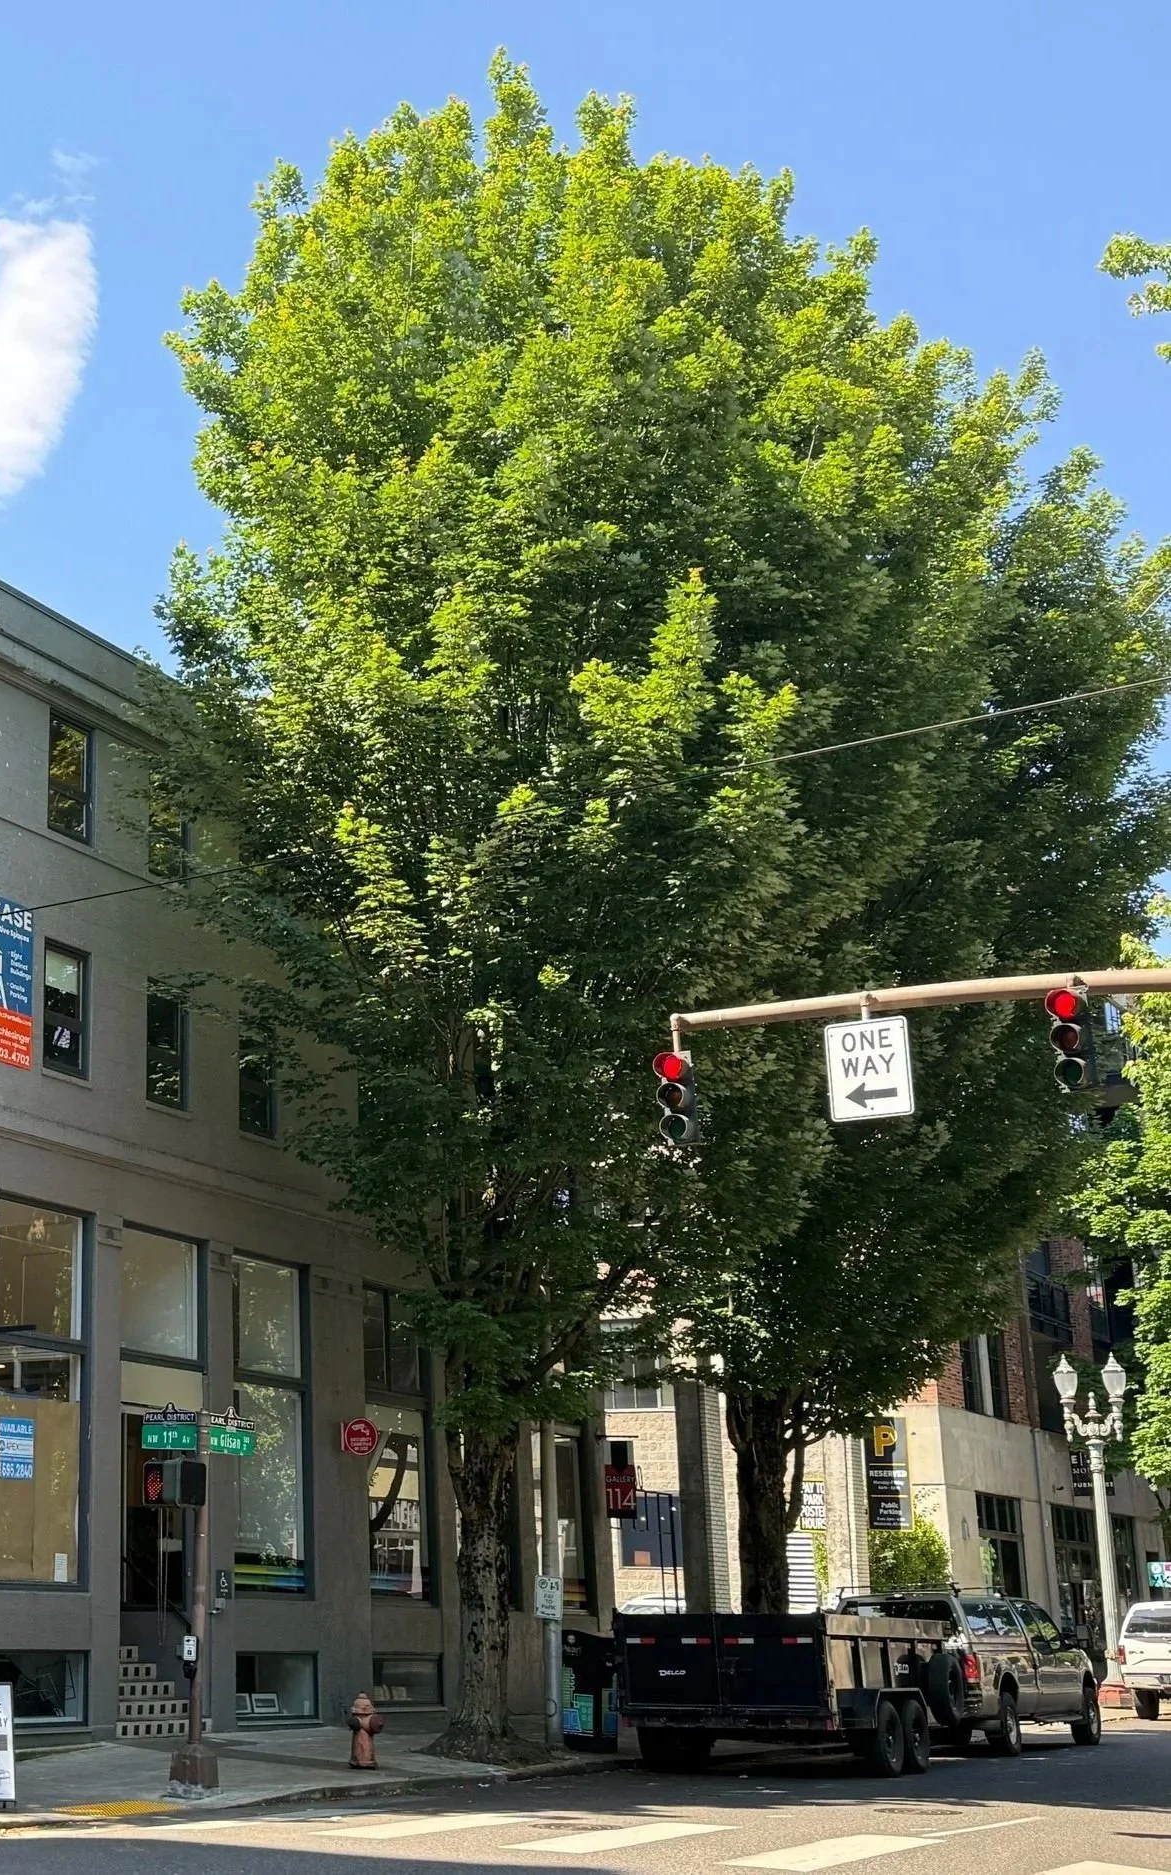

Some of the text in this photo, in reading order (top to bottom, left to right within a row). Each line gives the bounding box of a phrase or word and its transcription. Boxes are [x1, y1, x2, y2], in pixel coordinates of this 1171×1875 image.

[10, 929, 30, 943] Spaces
[11, 959, 28, 971] Distinct
[10, 967, 32, 981] Buildings
[10, 982, 25, 993] Onsite
[10, 990, 28, 1004] Parking
[841, 1027, 893, 1053] ONE
[841, 1052, 895, 1078] WAY
[145, 1413, 195, 1421] PEARL DISTRICT
[211, 1415, 254, 1429] EARL DISTRICT
[147, 1434, 158, 1444] NW
[220, 1433, 241, 1450] Glisan
[874, 1424, 898, 1457] P
[606, 1475, 635, 1483] GALLERY
[869, 1469, 907, 1478] RESERVED
[606, 1488, 636, 1510] 114
[803, 1493, 824, 1506] PARK
[879, 1508, 902, 1517] Parking
[801, 1517, 827, 1530] HOURS
[658, 1669, 686, 1677] DELCO
